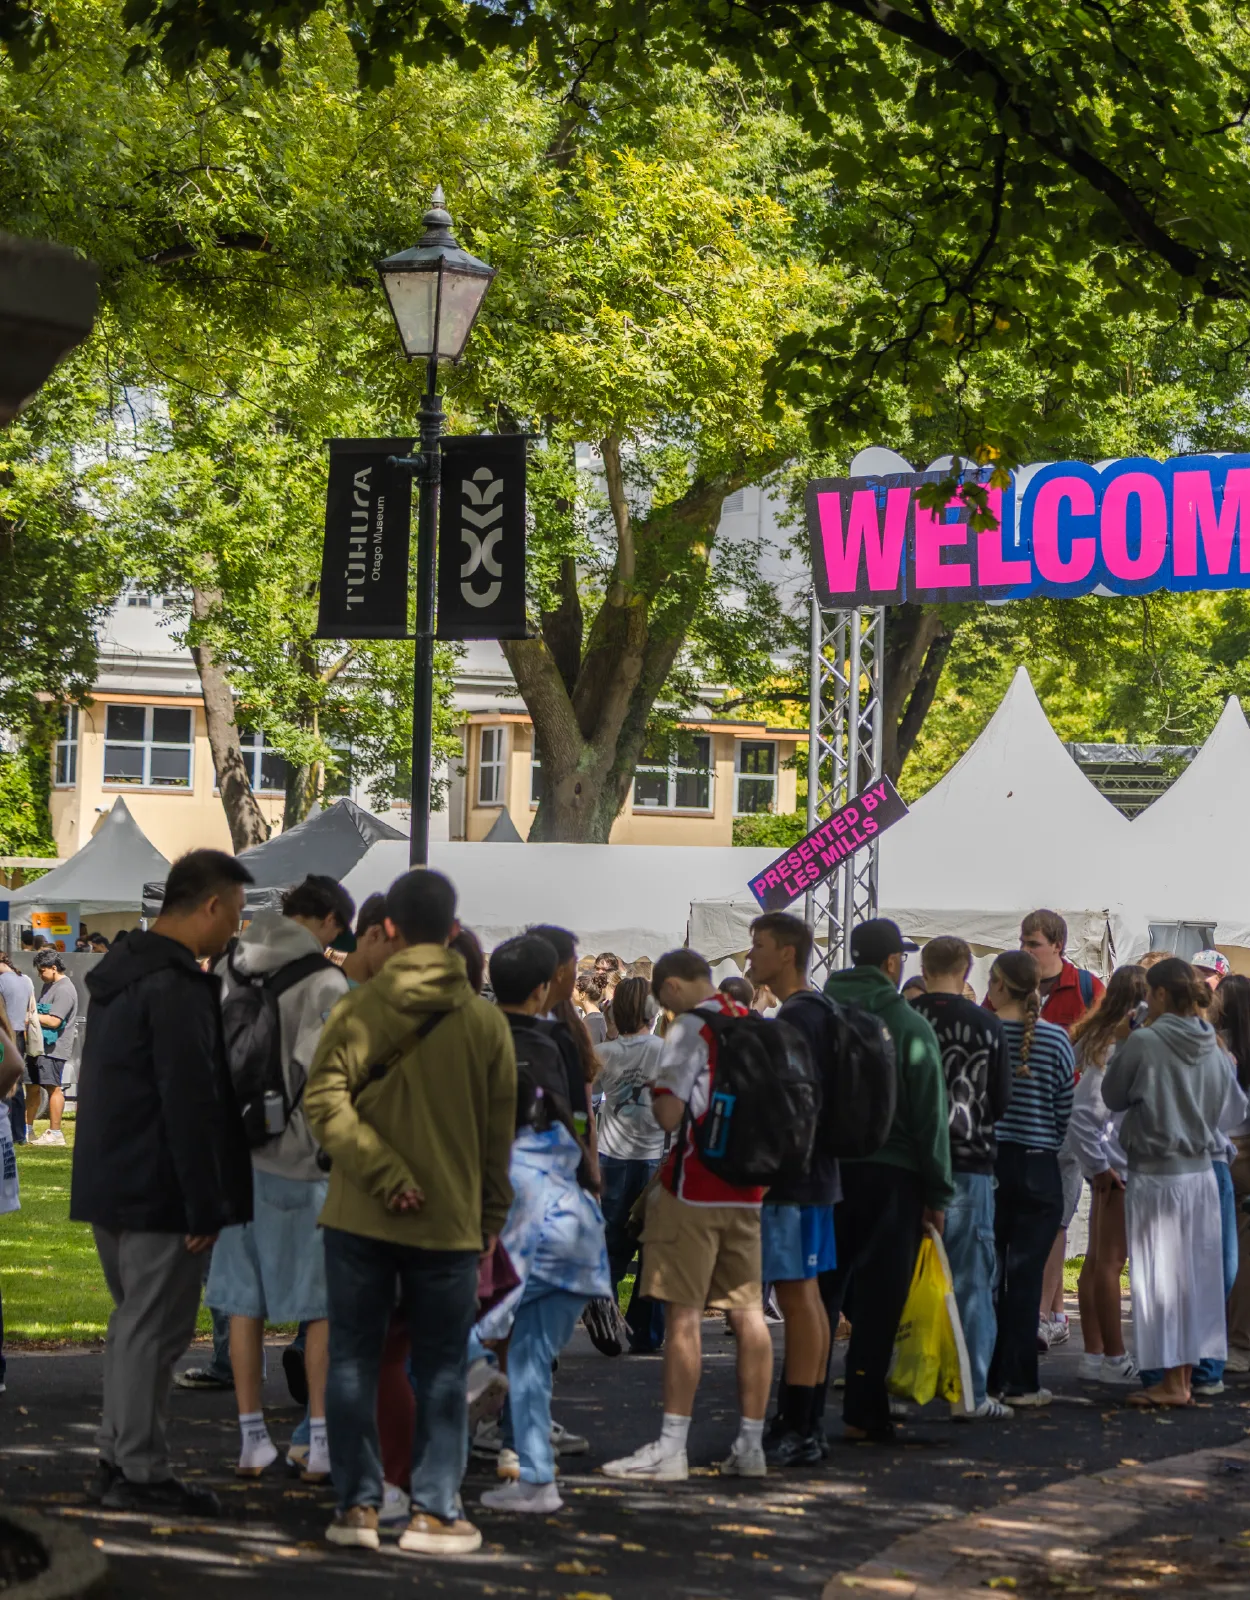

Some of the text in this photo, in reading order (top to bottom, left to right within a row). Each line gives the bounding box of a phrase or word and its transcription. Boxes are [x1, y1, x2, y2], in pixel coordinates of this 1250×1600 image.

[372, 496, 385, 581] Otago Museum
[753, 782, 888, 898] PRESENTED BY
[783, 816, 879, 897] LES MILLS
